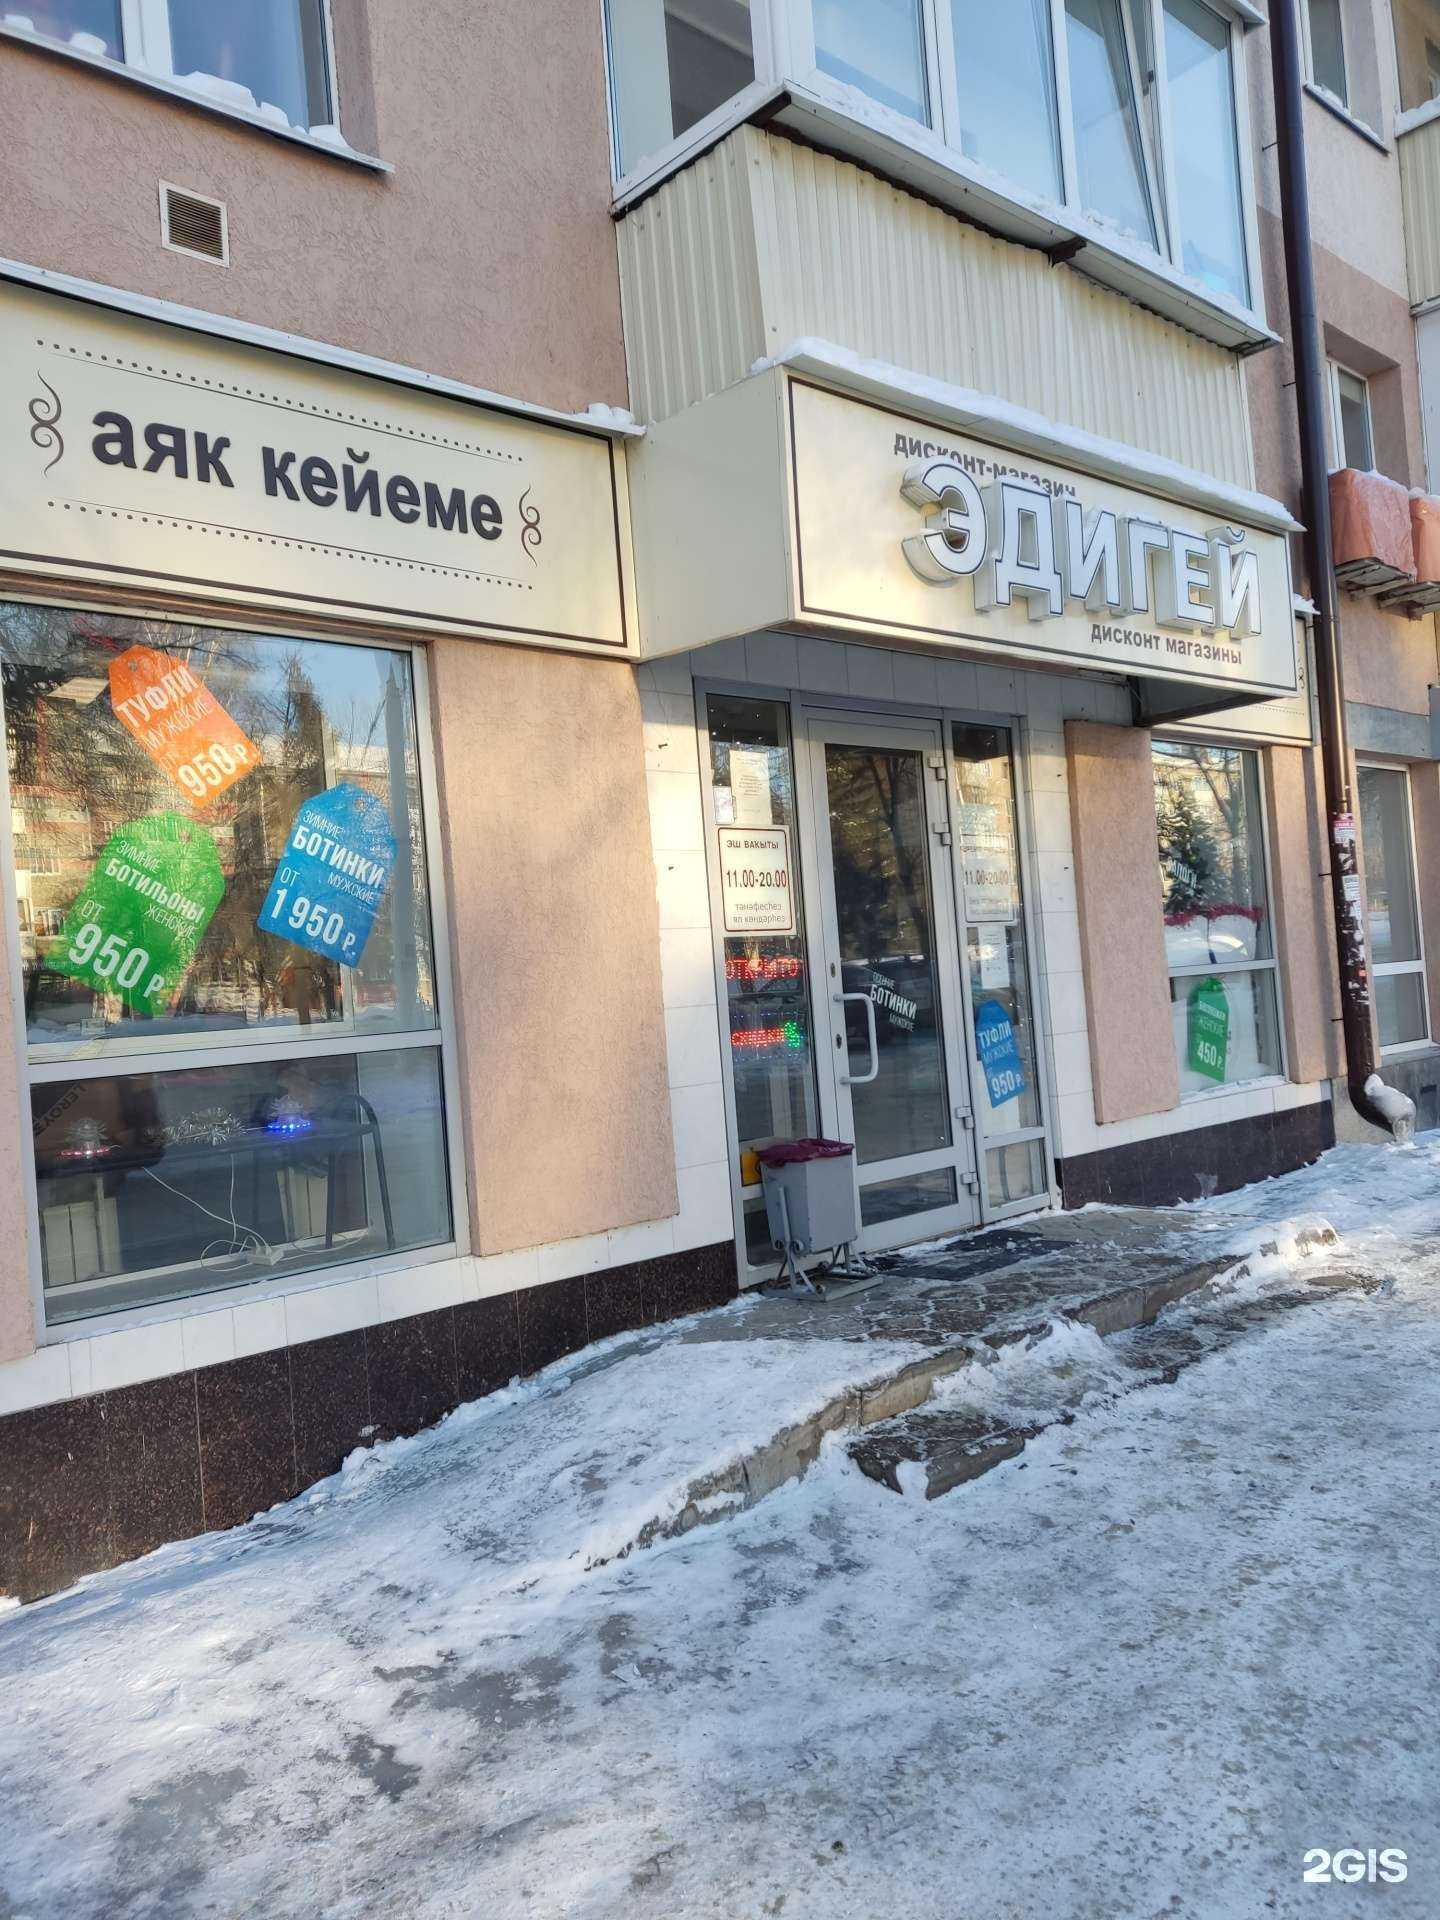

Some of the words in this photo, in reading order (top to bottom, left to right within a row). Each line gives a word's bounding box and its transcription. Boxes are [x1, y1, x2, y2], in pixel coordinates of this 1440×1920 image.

[91, 410, 235, 488] аяк
[262, 446, 504, 541] кейеме
[901, 457, 1263, 639] ЭДИГЕЙ
[1166, 637, 1242, 665] магазины
[116, 665, 199, 728] ТУФЛИ
[178, 743, 237, 796] 950
[303, 810, 344, 839] ЗИМНИЕ
[117, 840, 162, 874] ЗИМНИЕ
[292, 825, 385, 888] БОТИНКИ
[105, 858, 206, 923] БОТИЛЬОНЫ
[280, 867, 300, 887] ОТ
[327, 871, 376, 905] МУЖСКИЕ
[726, 869, 787, 888] 11.00-20.00
[81, 900, 105, 922] ОТ
[144, 905, 199, 939] ЖЕНСКИЕ
[288, 896, 344, 945] 950
[68, 923, 149, 988] 950
[870, 984, 917, 1019] БОТИНКИ
[978, 1020, 1012, 1049] ТУФЛИ
[991, 1070, 1016, 1098] 950
